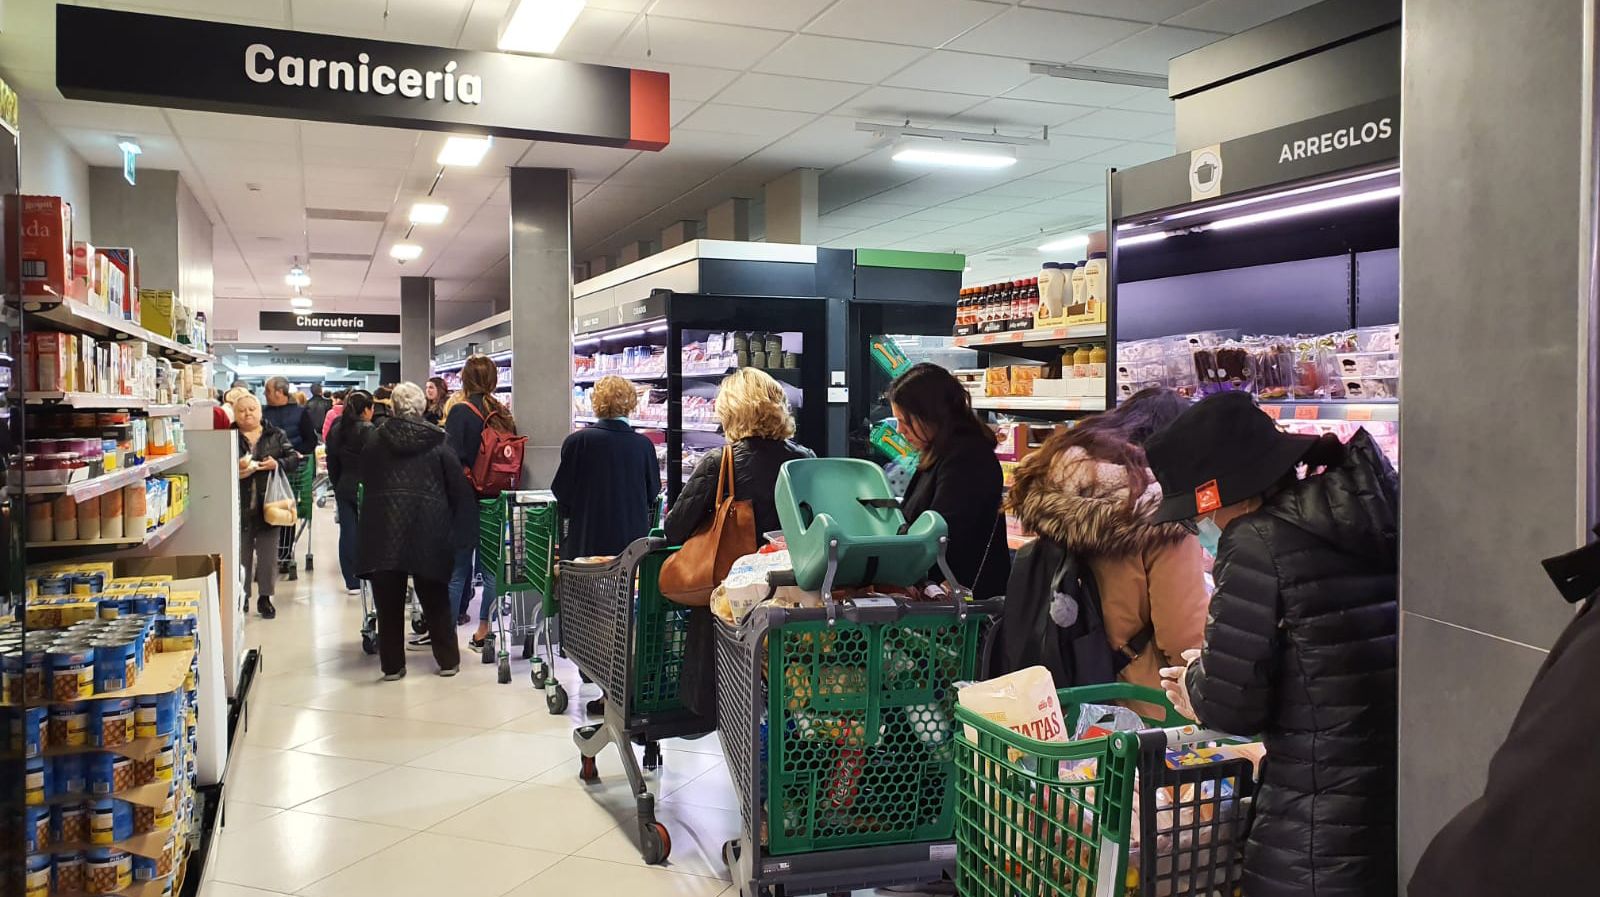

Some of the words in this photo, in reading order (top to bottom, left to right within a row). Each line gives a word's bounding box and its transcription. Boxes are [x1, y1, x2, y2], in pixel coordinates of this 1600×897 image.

[245, 43, 482, 105] Carnicería
[1278, 118, 1392, 164] ARREGLOS
[21, 219, 49, 237] da
[296, 316, 364, 328] Charcutería
